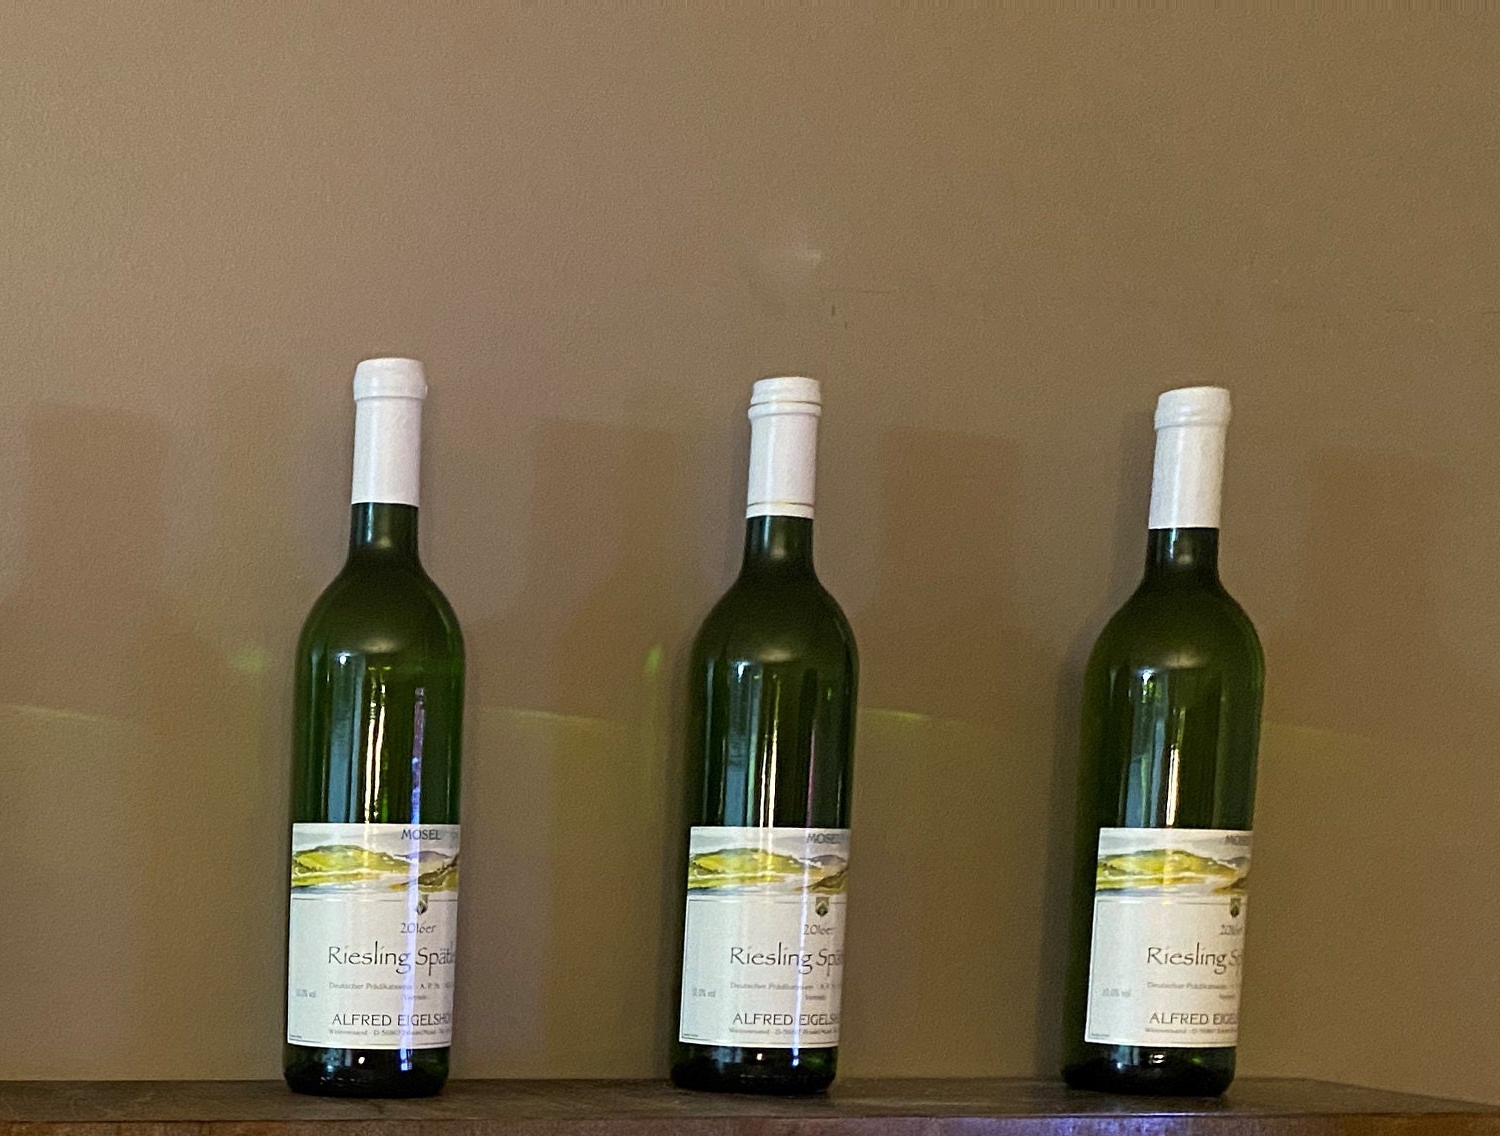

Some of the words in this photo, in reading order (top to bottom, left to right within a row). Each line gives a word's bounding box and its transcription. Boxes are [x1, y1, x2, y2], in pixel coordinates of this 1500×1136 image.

[400, 828, 442, 841] MOSEL
[328, 940, 412, 975] Riesling
[729, 941, 814, 975] Riesling
[1146, 941, 1228, 976] Riesling
[331, 1013, 392, 1027] ALFRED
[732, 1012, 793, 1026] ALFRED
[1149, 1012, 1209, 1025] ALFRED
